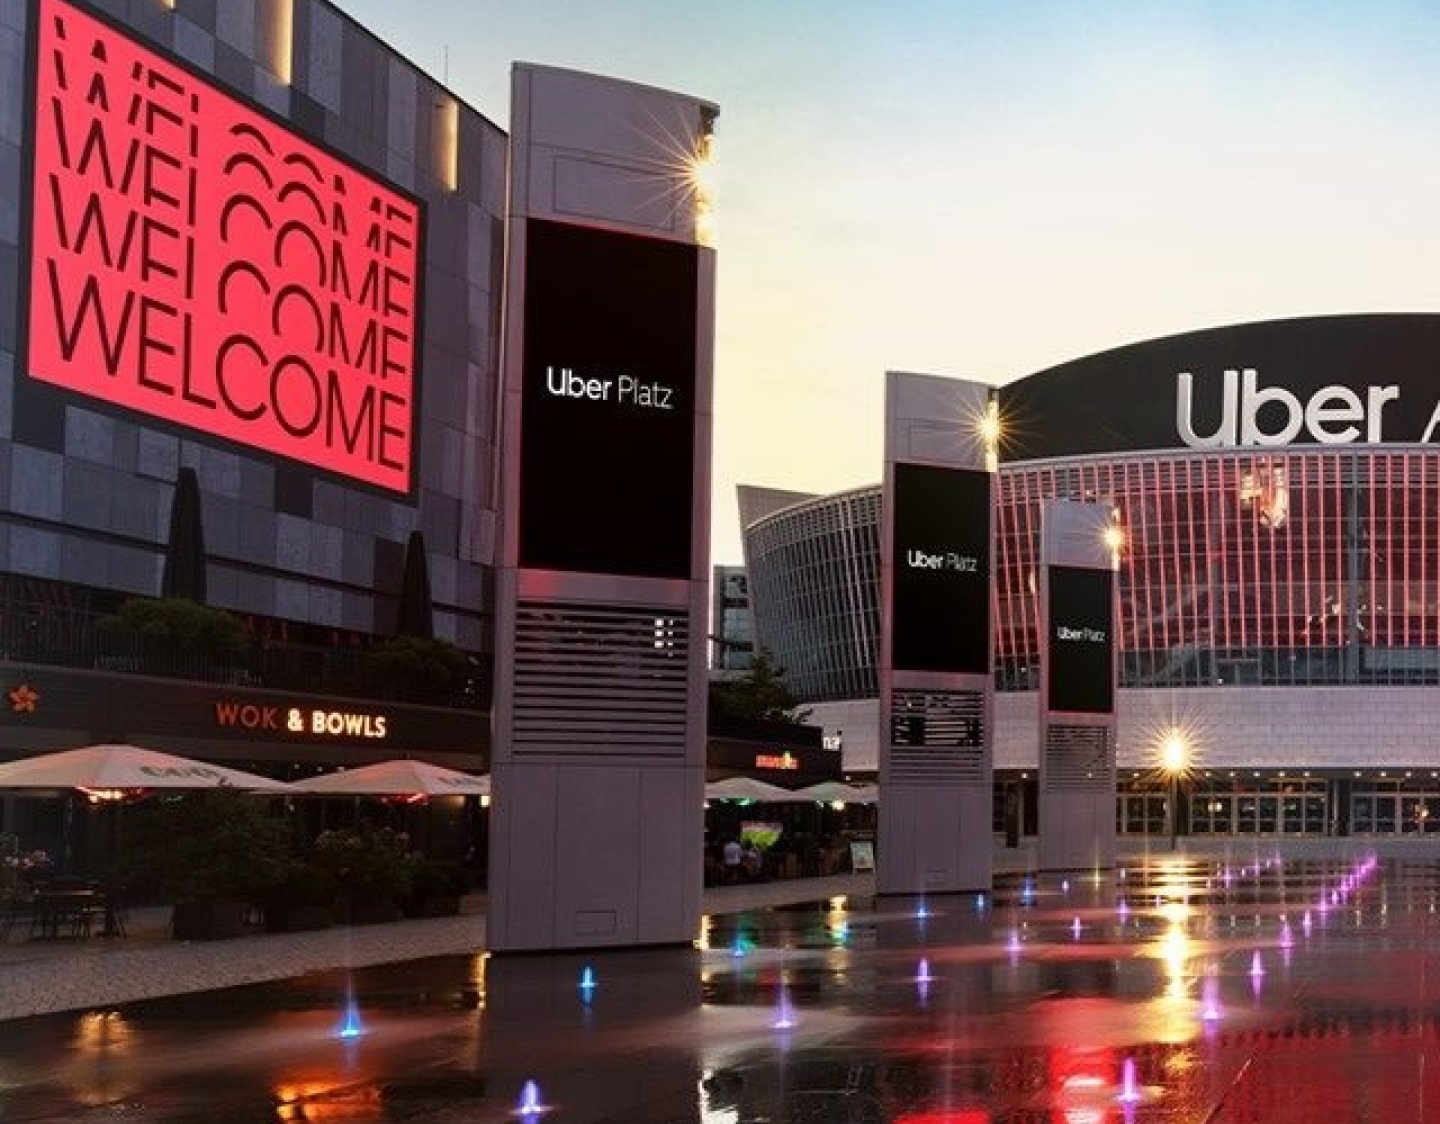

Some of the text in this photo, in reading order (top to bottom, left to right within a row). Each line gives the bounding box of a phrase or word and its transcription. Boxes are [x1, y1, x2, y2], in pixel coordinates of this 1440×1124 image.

[46, 258, 406, 472] WELCOME
[546, 365, 675, 410] Uber Platz
[1176, 367, 1399, 447] Uber
[908, 549, 979, 572] Uber Platz
[1057, 626, 1083, 640] Uber
[216, 702, 387, 739] WOK & BOWLS
